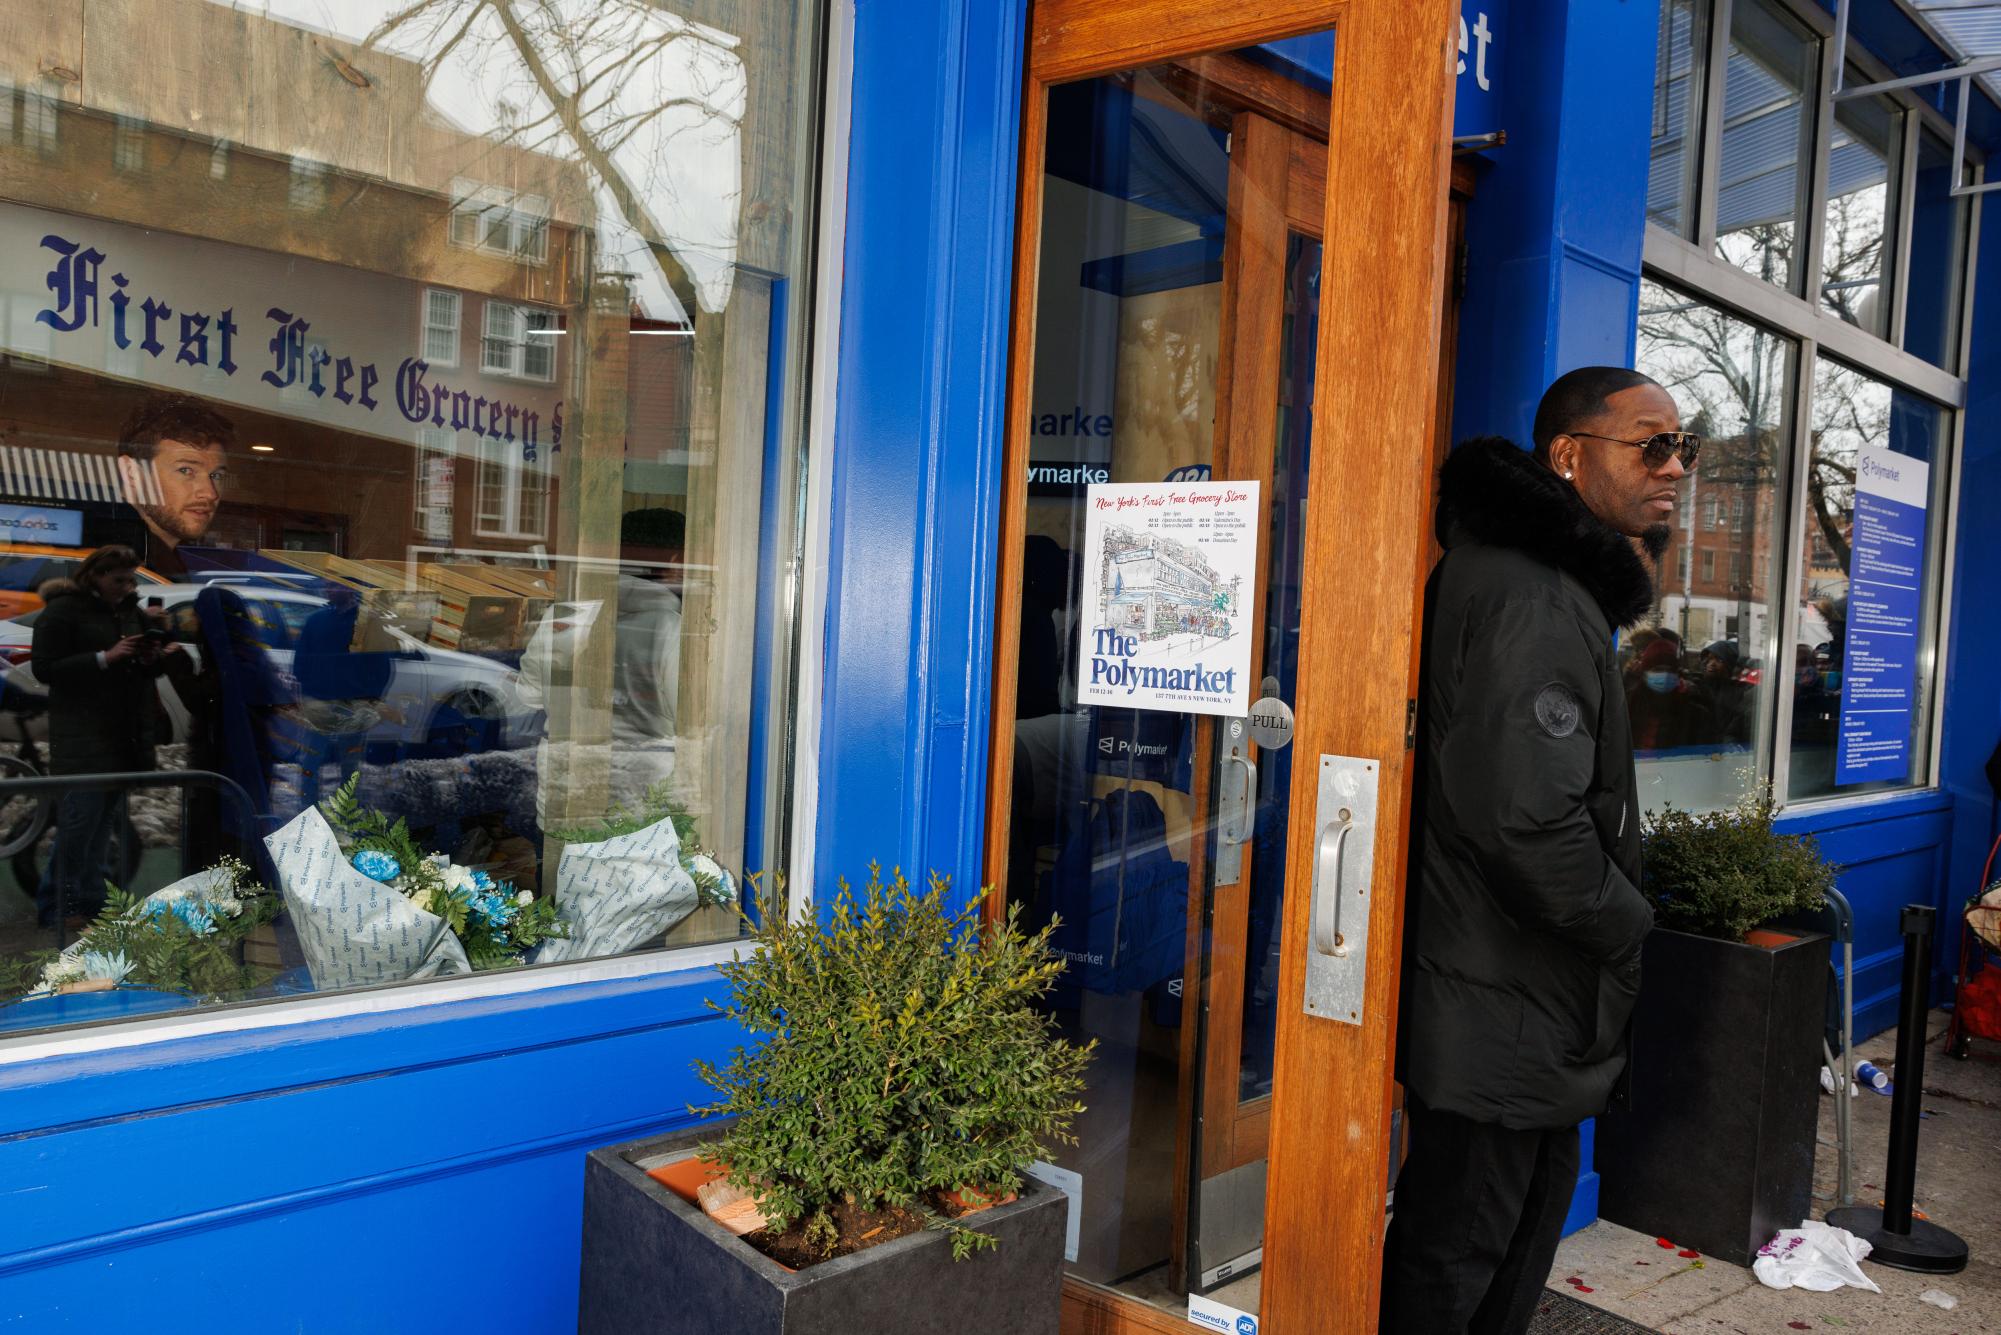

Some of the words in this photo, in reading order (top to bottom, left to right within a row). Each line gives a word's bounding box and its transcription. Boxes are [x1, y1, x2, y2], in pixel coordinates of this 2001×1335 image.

[35, 233, 239, 376] First
[261, 307, 379, 411] Free
[395, 356, 540, 464] Grocery
[1026, 463, 1111, 484] ymarke
[1870, 460, 1901, 482] Polymarket
[1096, 497, 1114, 510] New
[1117, 495, 1140, 511] York's
[1142, 494, 1165, 508] First
[1168, 492, 1186, 506] Free
[1189, 491, 1223, 507] Grocery
[1224, 489, 1248, 503] Store
[1092, 627, 1138, 658] The
[1090, 657, 1237, 695] Polymarket
[1252, 714, 1288, 730] PULL
[1190, 1308, 1220, 1325] secured
[1220, 1318, 1231, 1328] by
[1239, 1322, 1255, 1335] ADT
